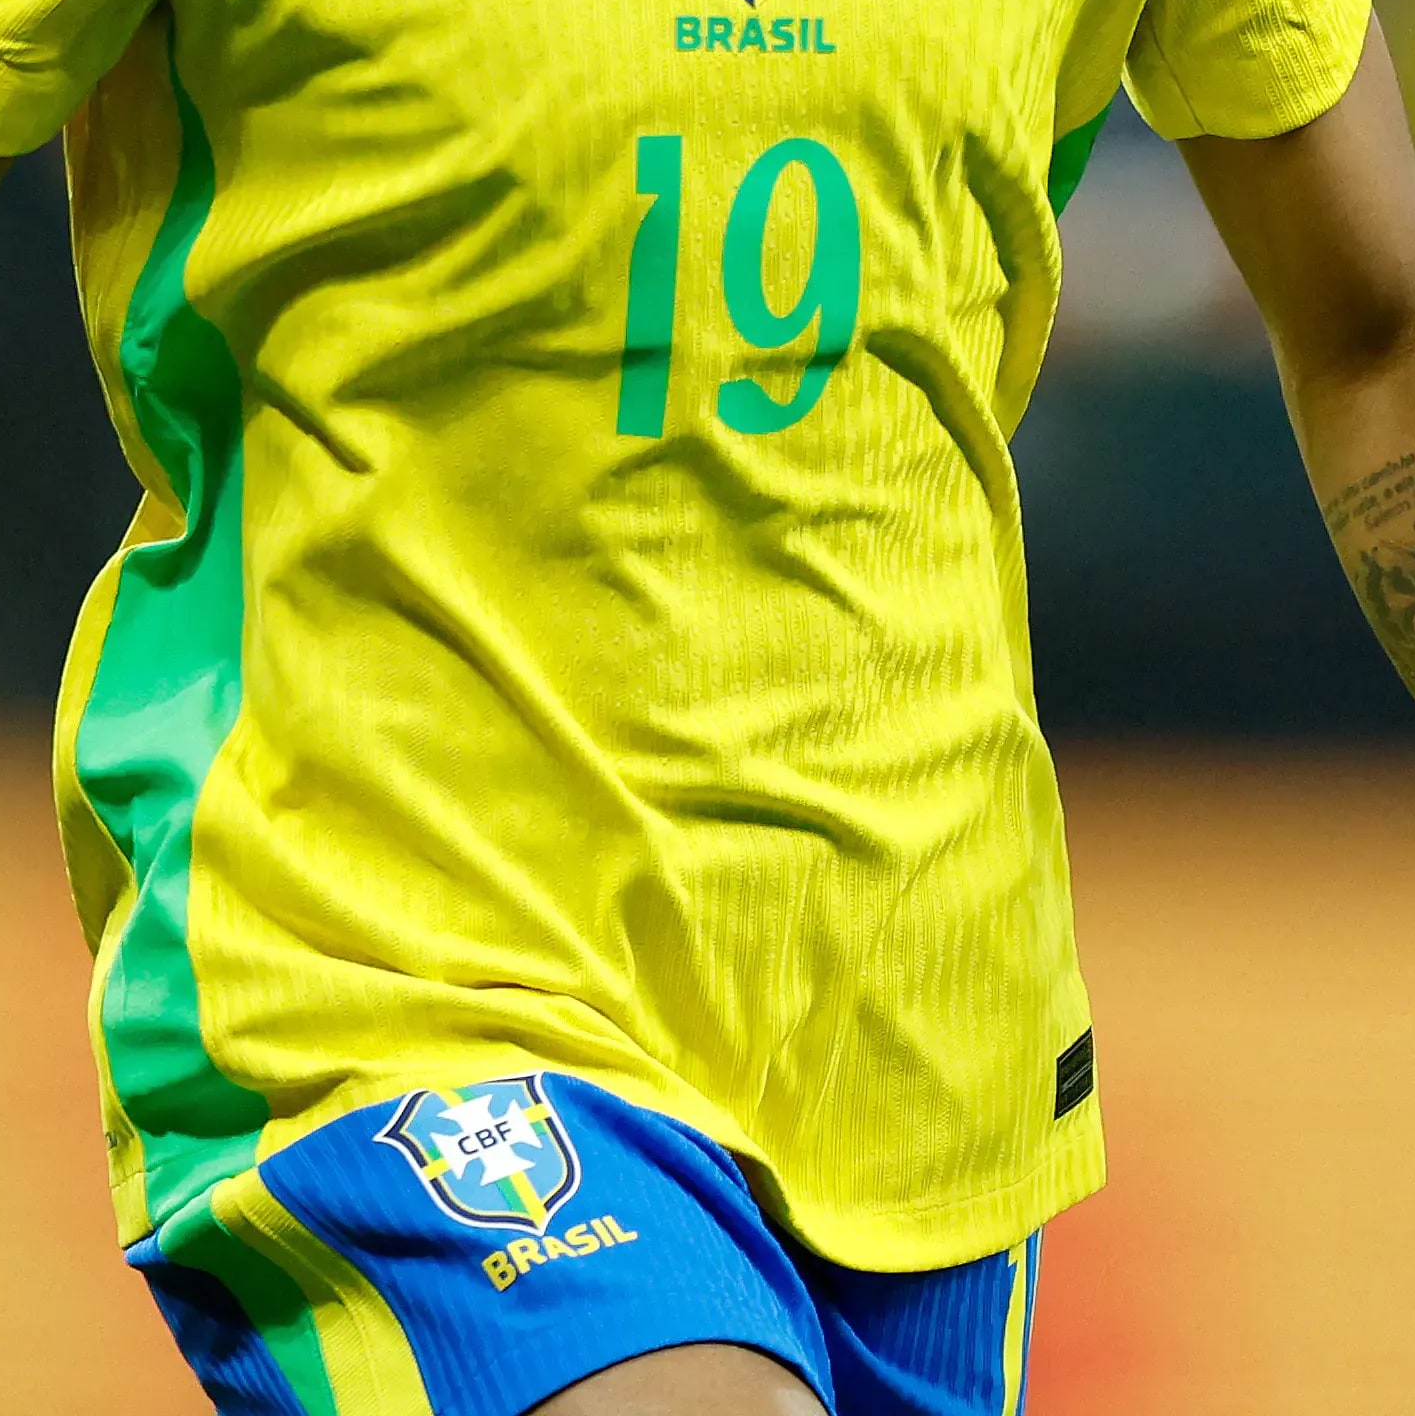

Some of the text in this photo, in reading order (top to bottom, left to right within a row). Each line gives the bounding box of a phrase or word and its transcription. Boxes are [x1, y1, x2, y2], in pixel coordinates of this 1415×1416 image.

[674, 16, 836, 54] BRASIL
[616, 135, 861, 438] 19
[457, 1121, 512, 1156] CBF
[481, 1215, 638, 1292] BRASIL
